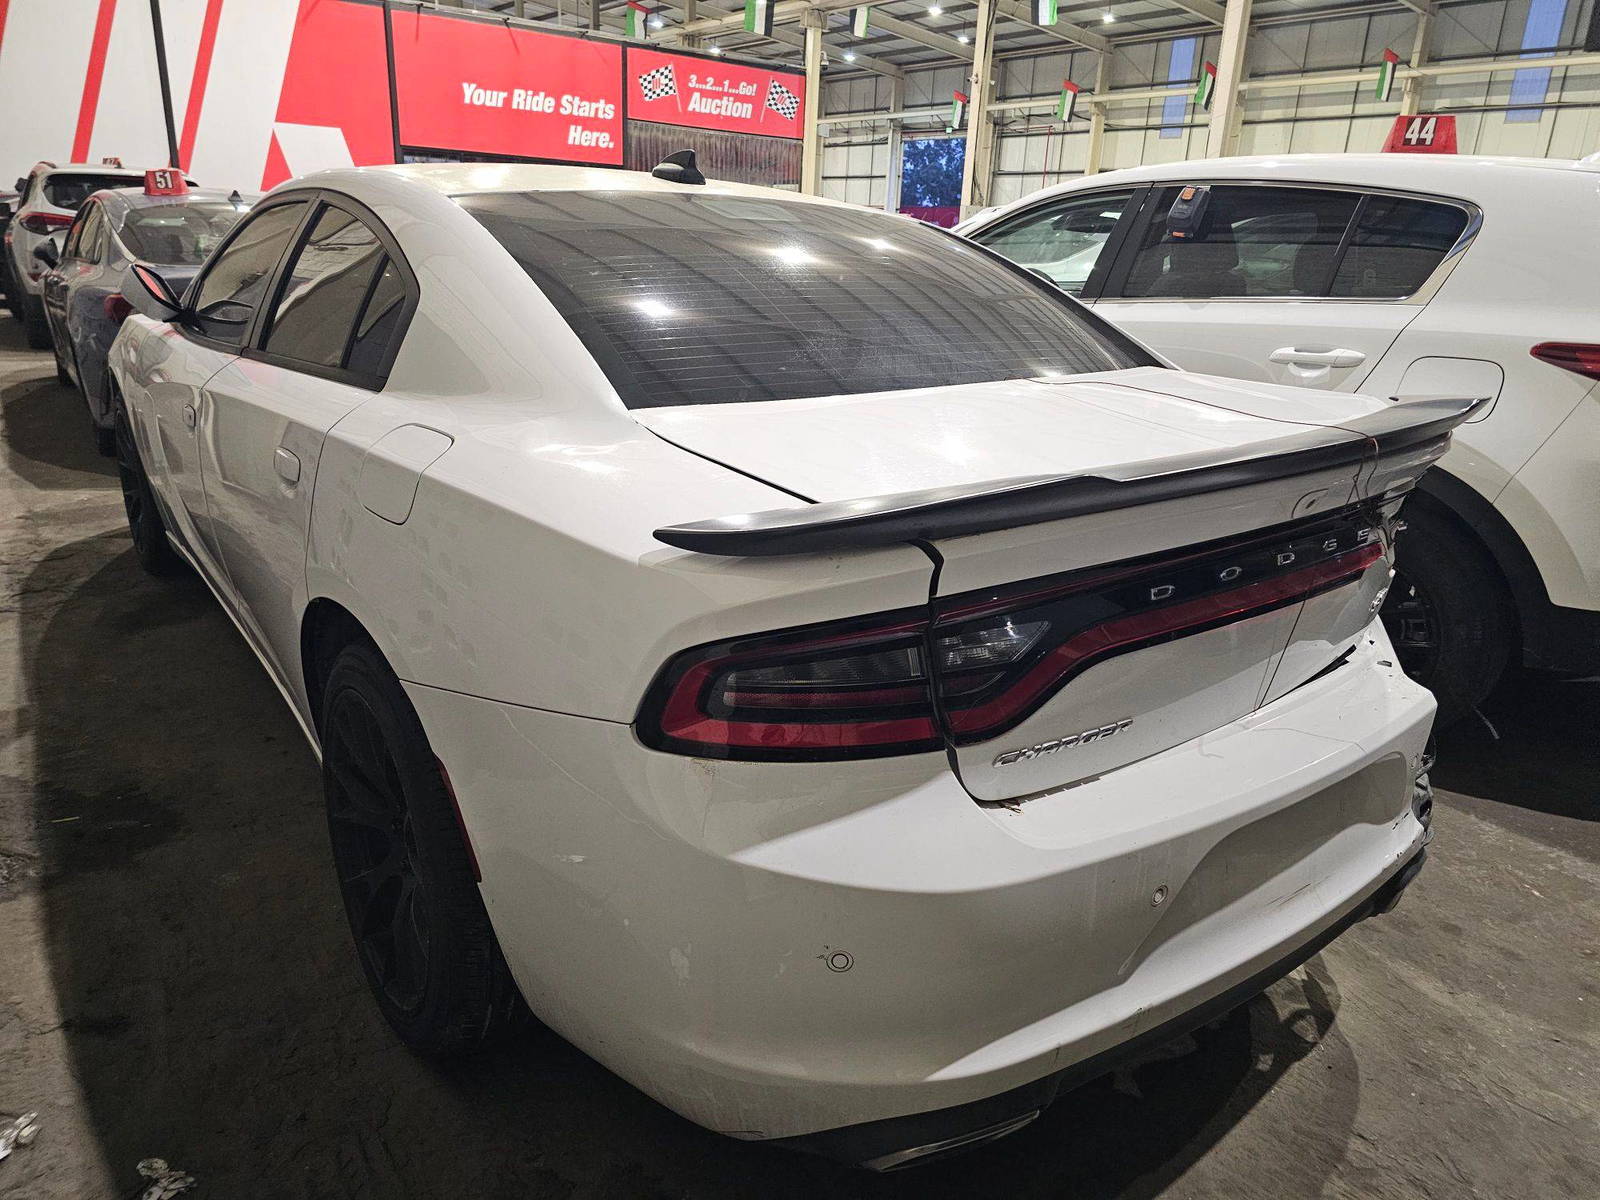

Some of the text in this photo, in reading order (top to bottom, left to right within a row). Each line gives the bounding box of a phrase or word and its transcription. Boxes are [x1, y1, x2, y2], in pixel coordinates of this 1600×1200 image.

[462, 82, 616, 120] Your Ride Starts
[687, 91, 753, 119] Auction
[567, 124, 615, 149] Here.
[1404, 116, 1437, 145] 44
[155, 171, 173, 189] 51
[1151, 528, 1372, 600] DODGE
